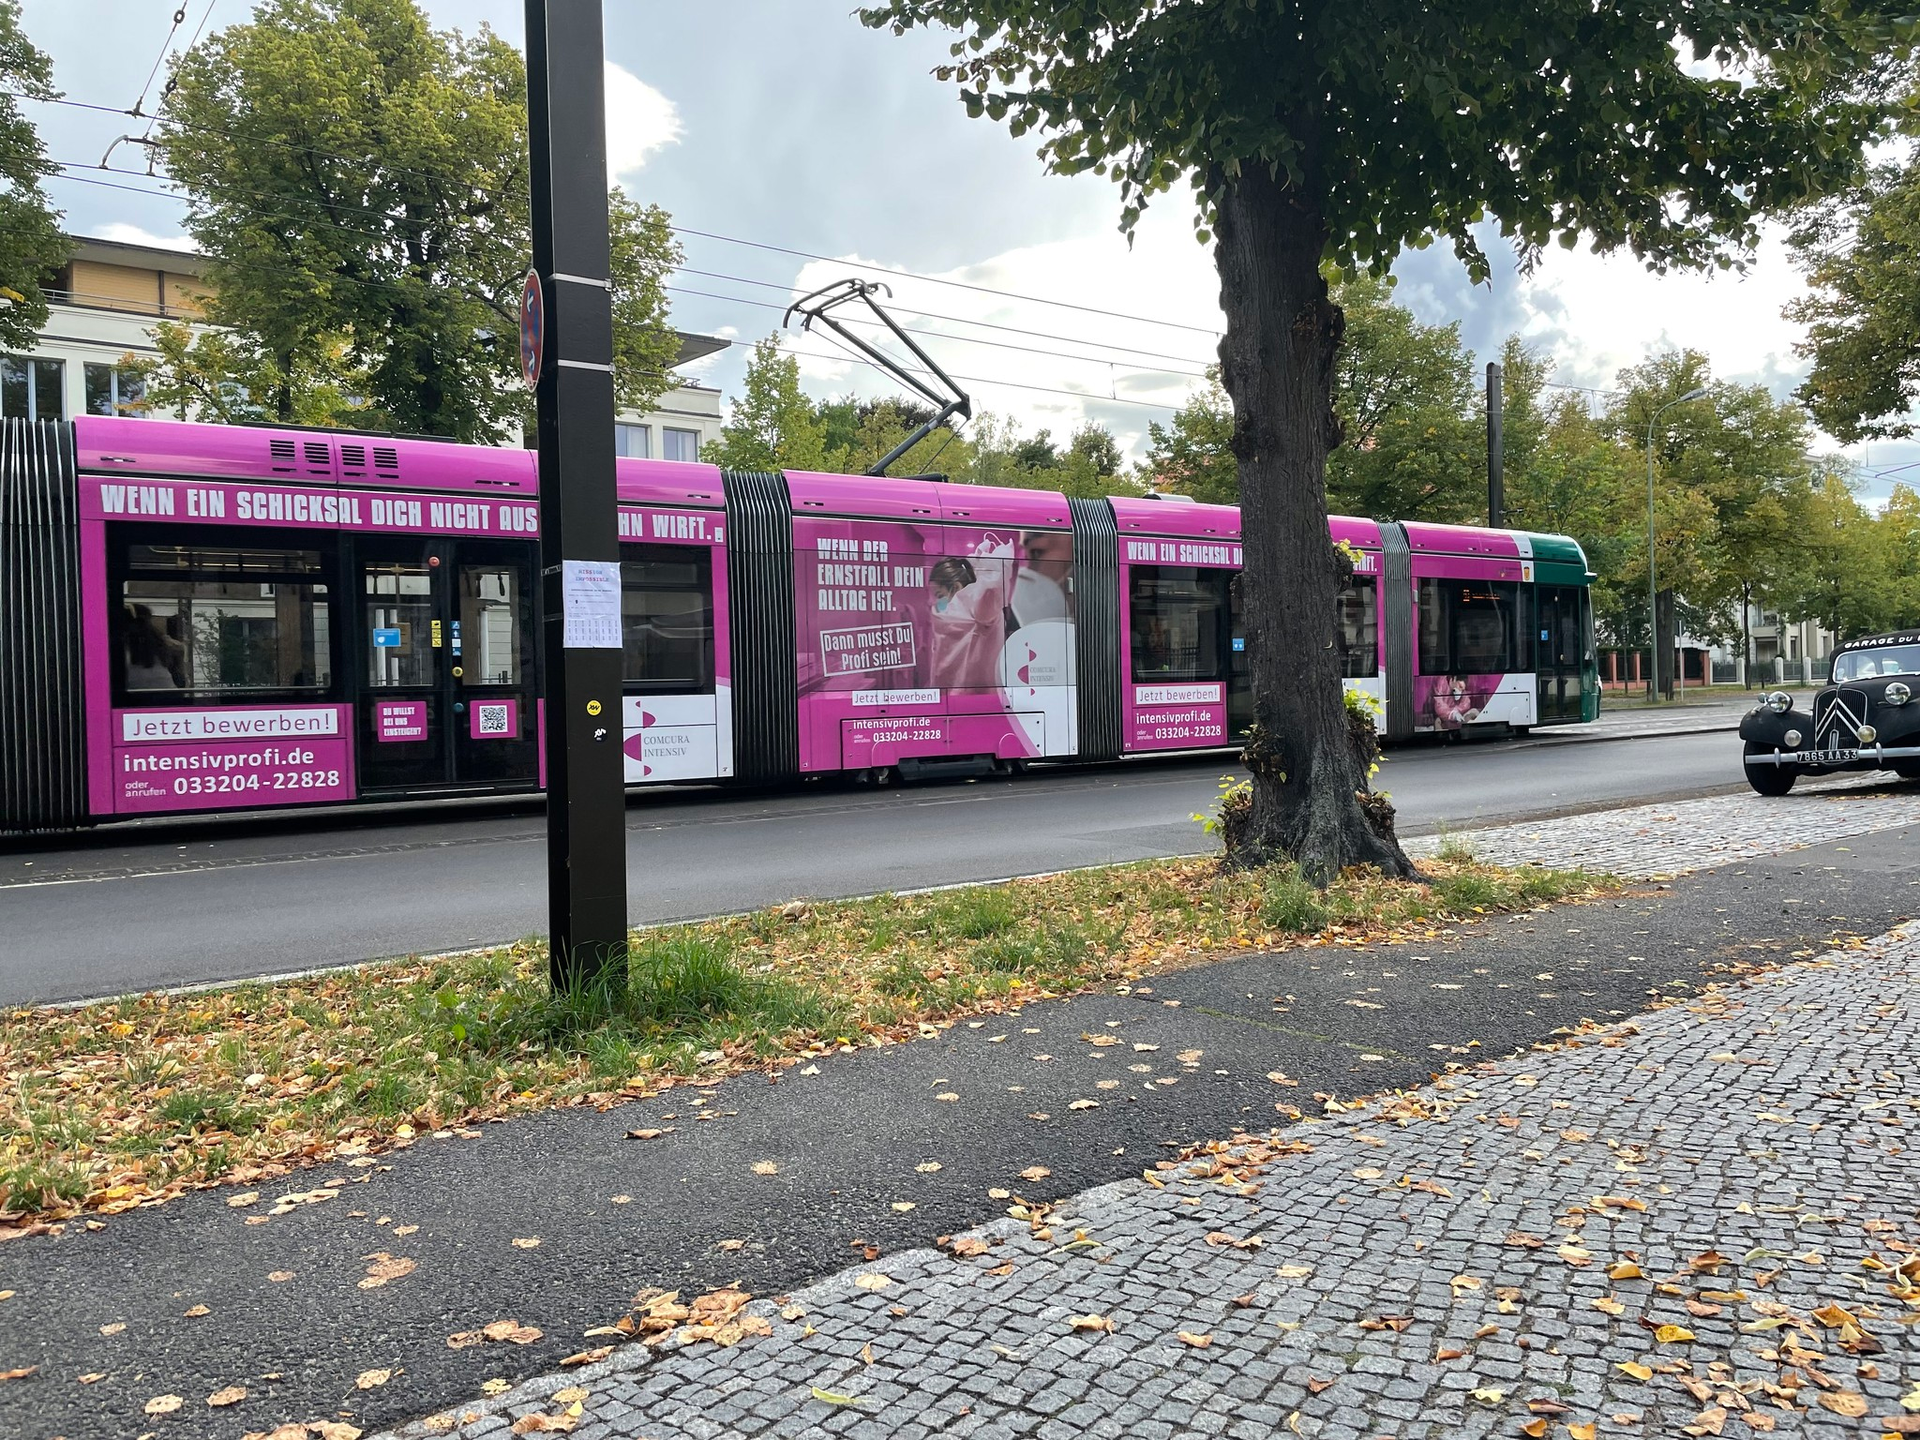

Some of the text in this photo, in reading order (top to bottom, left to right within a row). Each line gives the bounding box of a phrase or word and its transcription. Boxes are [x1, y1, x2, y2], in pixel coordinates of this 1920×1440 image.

[100, 483, 175, 516] WENN
[187, 488, 226, 518] EIN
[237, 491, 362, 525] SCHICKSAL
[371, 498, 422, 528] DICH
[430, 501, 491, 531] NICHT
[499, 505, 538, 532] AUS
[652, 514, 712, 540] WIRFT.
[817, 538, 888, 562] WENN DER
[1127, 541, 1156, 561] WENN
[1160, 543, 1176, 562] EIN
[1180, 545, 1230, 565] SCHICKSAL
[817, 563, 925, 588] ERNSTFALL DEIN
[818, 589, 897, 612] ALLTAG IST.
[823, 627, 911, 652] Dann musst Du
[1844, 637, 1894, 649] GARAGE
[841, 647, 901, 670] Profi sein!
[855, 691, 937, 703] Jetzt bewerben!
[1139, 688, 1218, 702] Jetzt bewerben!
[132, 713, 330, 737] Jetzt bewerben!
[853, 717, 931, 729] intensivprofi.de
[1136, 710, 1212, 725] intensivprofi.de
[643, 735, 690, 745] COMCURA
[873, 729, 941, 742] 033204-22828
[1155, 725, 1222, 740] 033204-22828
[644, 747, 688, 758] INTENSIV
[1798, 750, 1857, 762] 7865 AA 33
[124, 748, 315, 773] intensivprofi.de
[125, 780, 149, 790] oder
[173, 770, 340, 796] 033204-22828
[125, 787, 166, 798] anrufen
